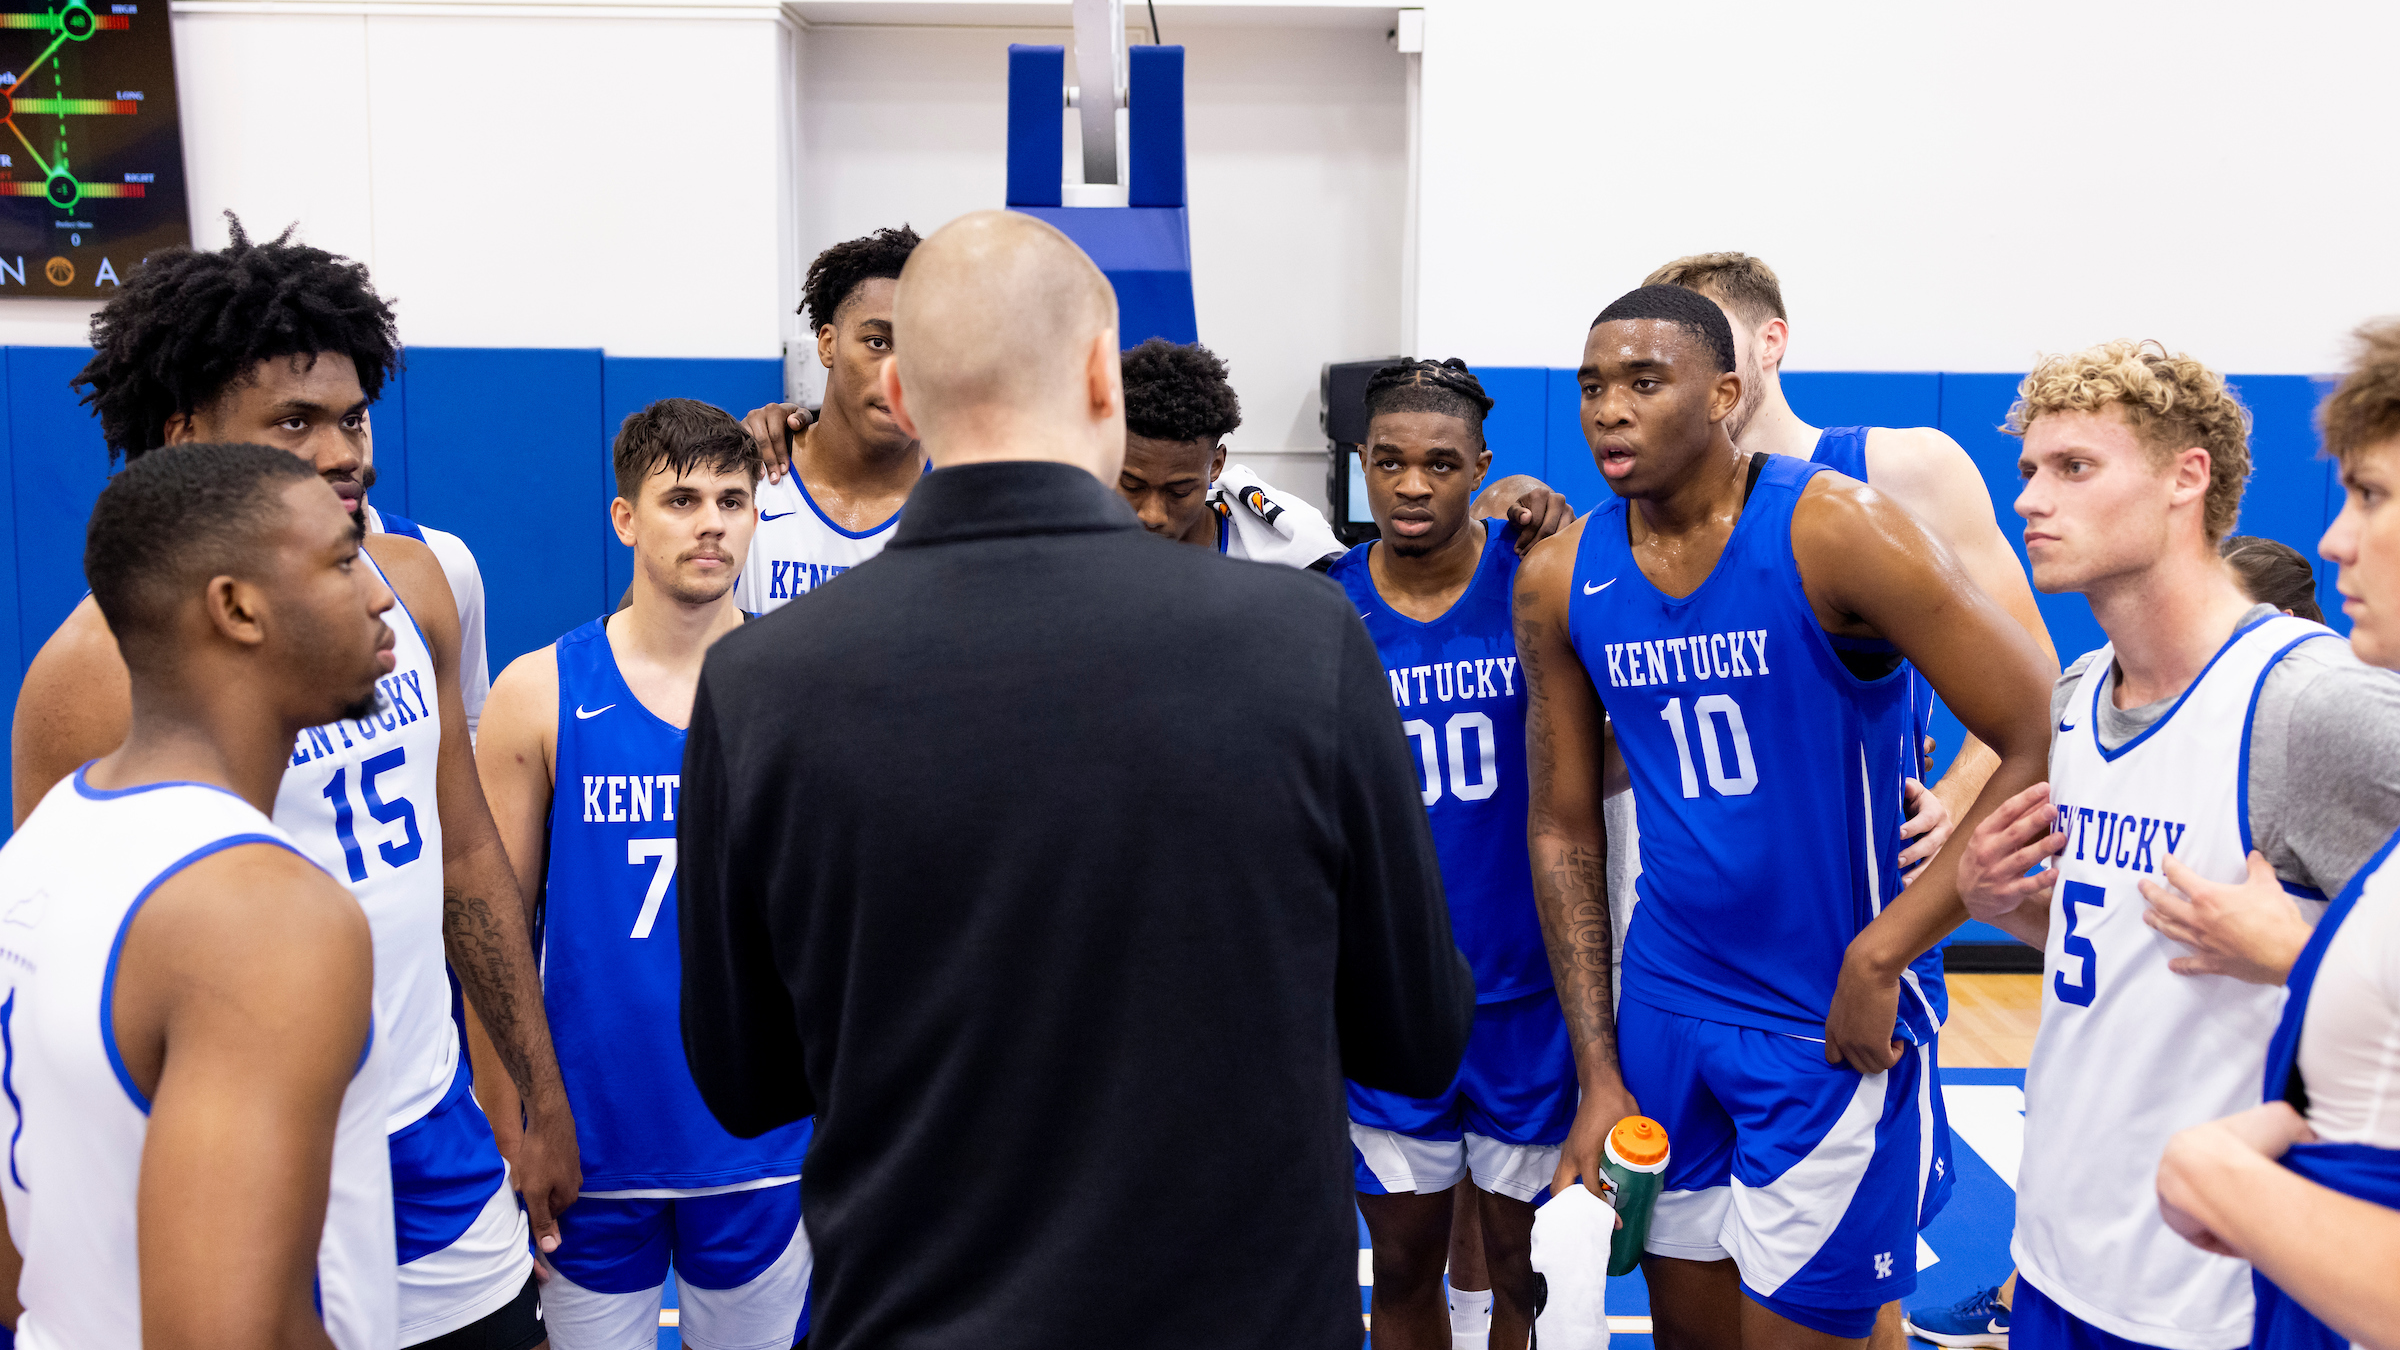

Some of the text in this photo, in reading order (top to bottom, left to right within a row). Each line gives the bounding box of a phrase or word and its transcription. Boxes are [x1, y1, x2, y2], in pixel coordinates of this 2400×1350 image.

[116, 91, 144, 101] LONG
[70, 232, 82, 247] 0
[1385, 656, 1517, 708] NTUCKY
[1605, 629, 1770, 687] KENTUCKY
[287, 669, 429, 769] ENTUCKY
[1660, 693, 1759, 798] 10
[322, 746, 423, 884] 15
[627, 838, 678, 939] 7
[2054, 880, 2106, 1008] 5
